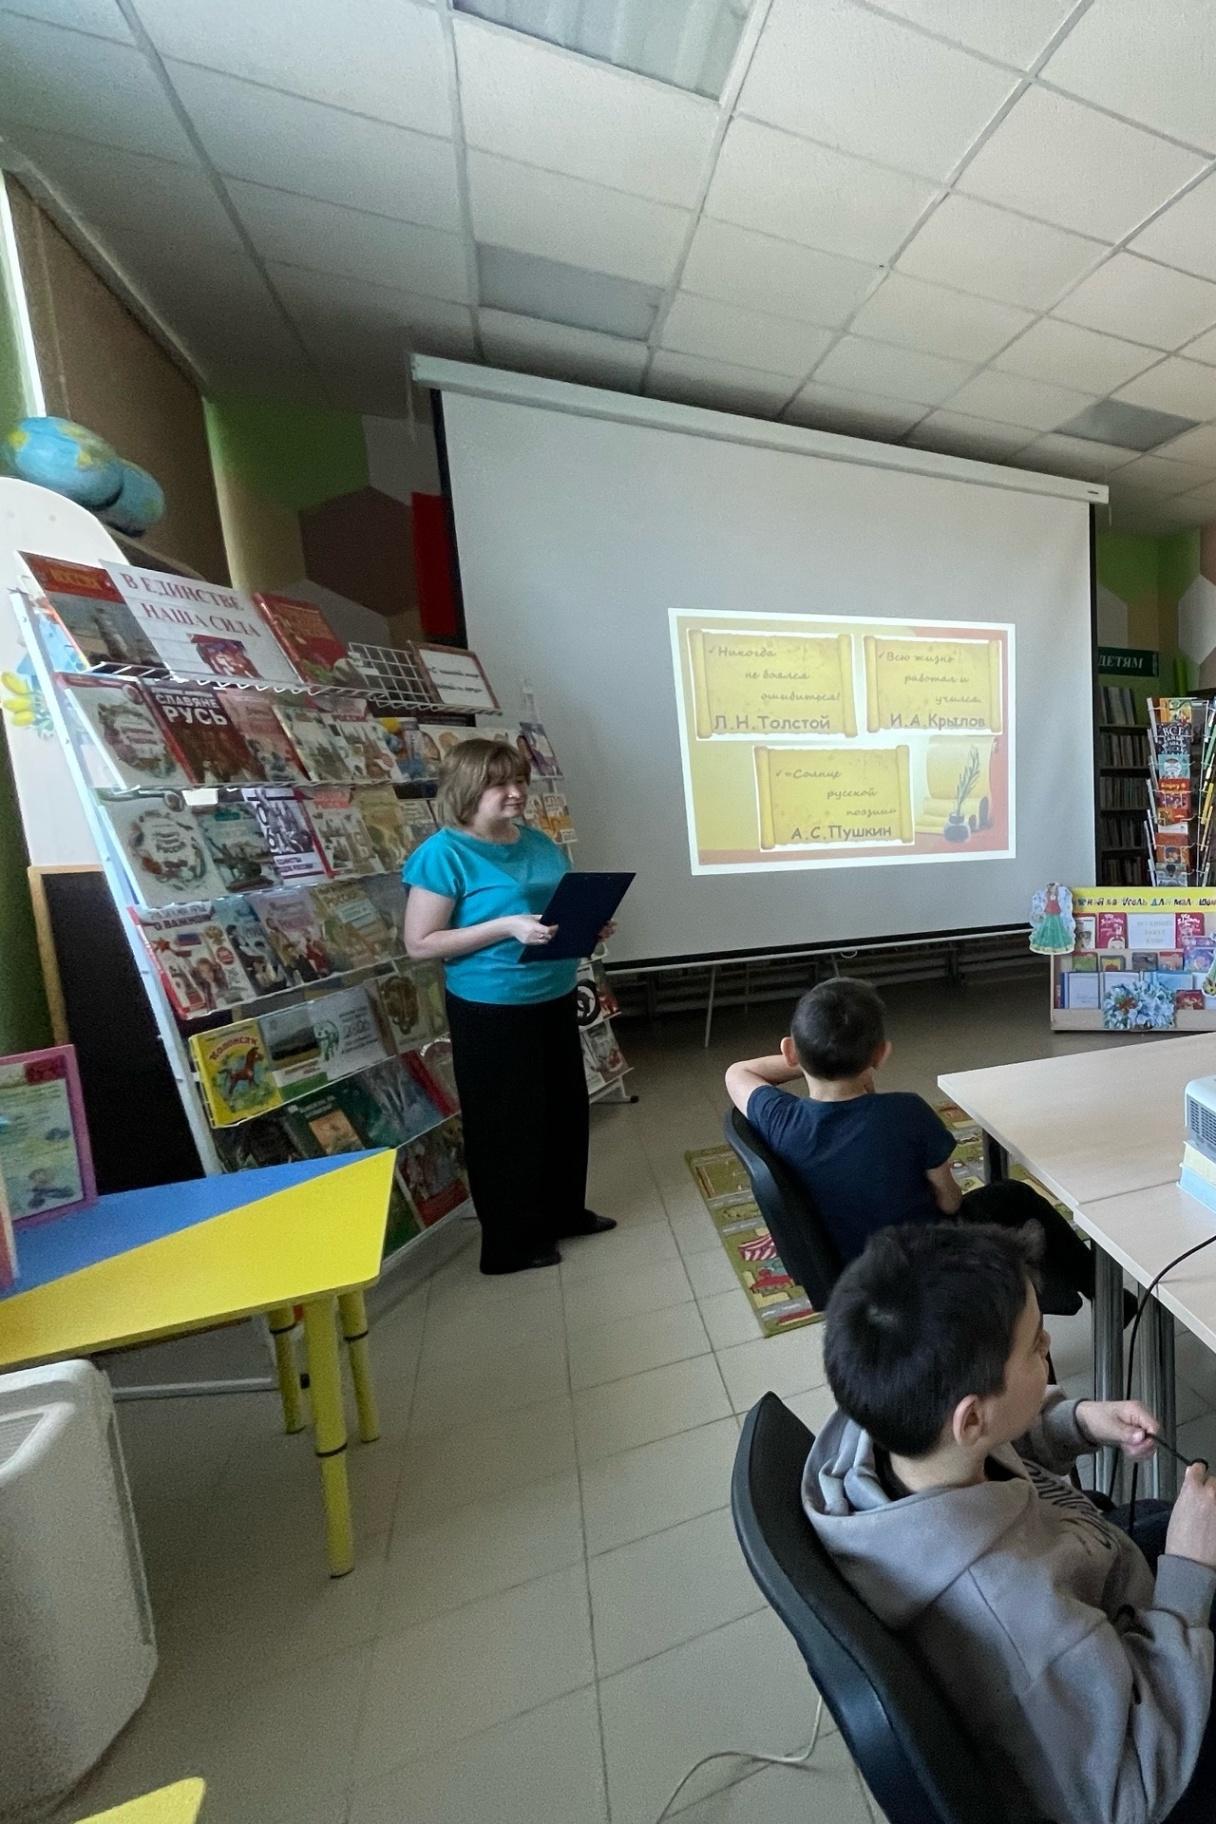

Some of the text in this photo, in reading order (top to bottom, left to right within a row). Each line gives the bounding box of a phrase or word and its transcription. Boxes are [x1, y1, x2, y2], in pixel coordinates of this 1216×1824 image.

[120, 572, 139, 590] В
[141, 602, 208, 629] НАША
[154, 694, 219, 710] СЛАВЯНЕ
[163, 706, 229, 726] РУСЬ
[713, 714, 831, 731] Л.Н.Толстой
[889, 713, 986, 731] И.А.Крылов
[790, 824, 893, 842] А.С.Пушкин
